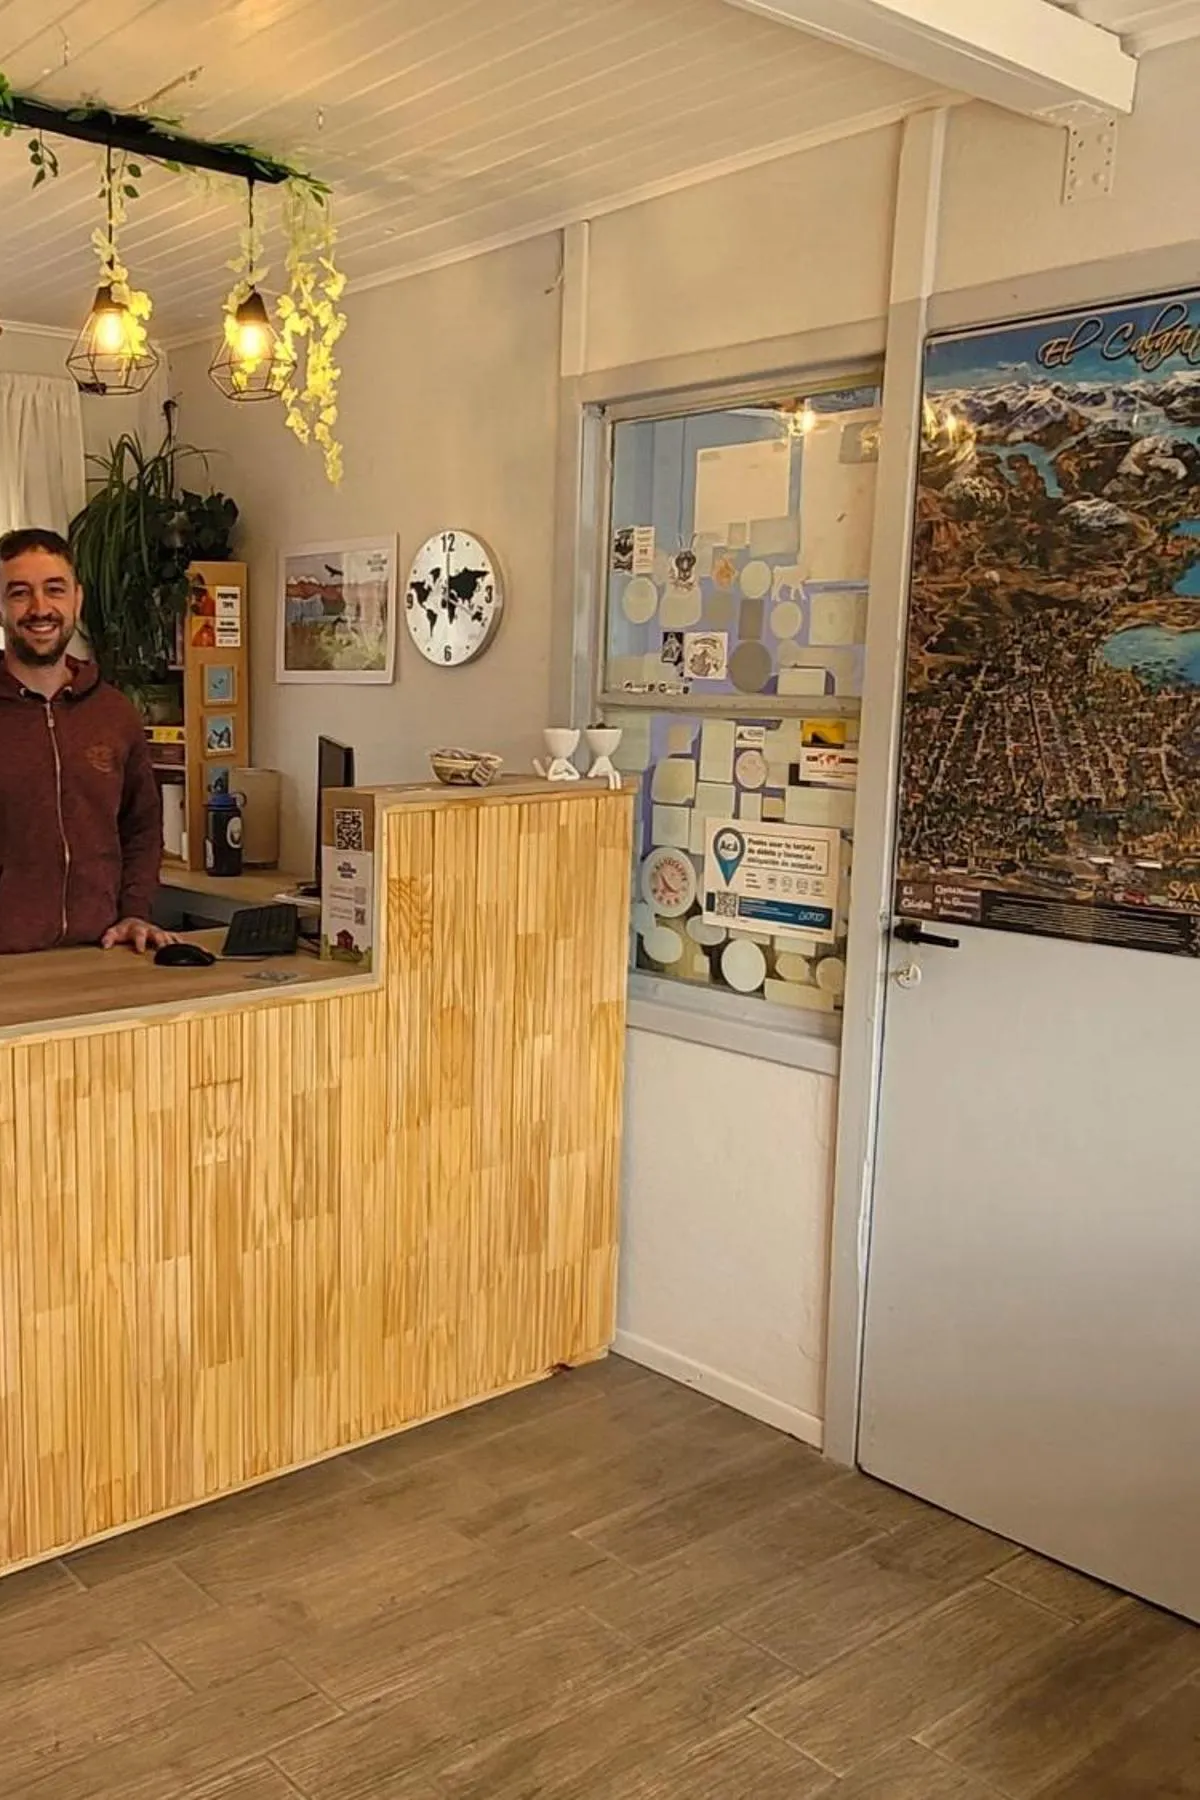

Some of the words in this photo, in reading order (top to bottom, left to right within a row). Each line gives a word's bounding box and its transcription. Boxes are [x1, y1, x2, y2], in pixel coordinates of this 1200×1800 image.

[1038, 316, 1104, 368] El
[441, 533, 455, 552] 12
[406, 593, 414, 610] 9
[484, 585, 493, 603] 3
[444, 645, 452, 661] 6
[720, 839, 738, 852] Acá
[793, 843, 815, 851] tarjeta
